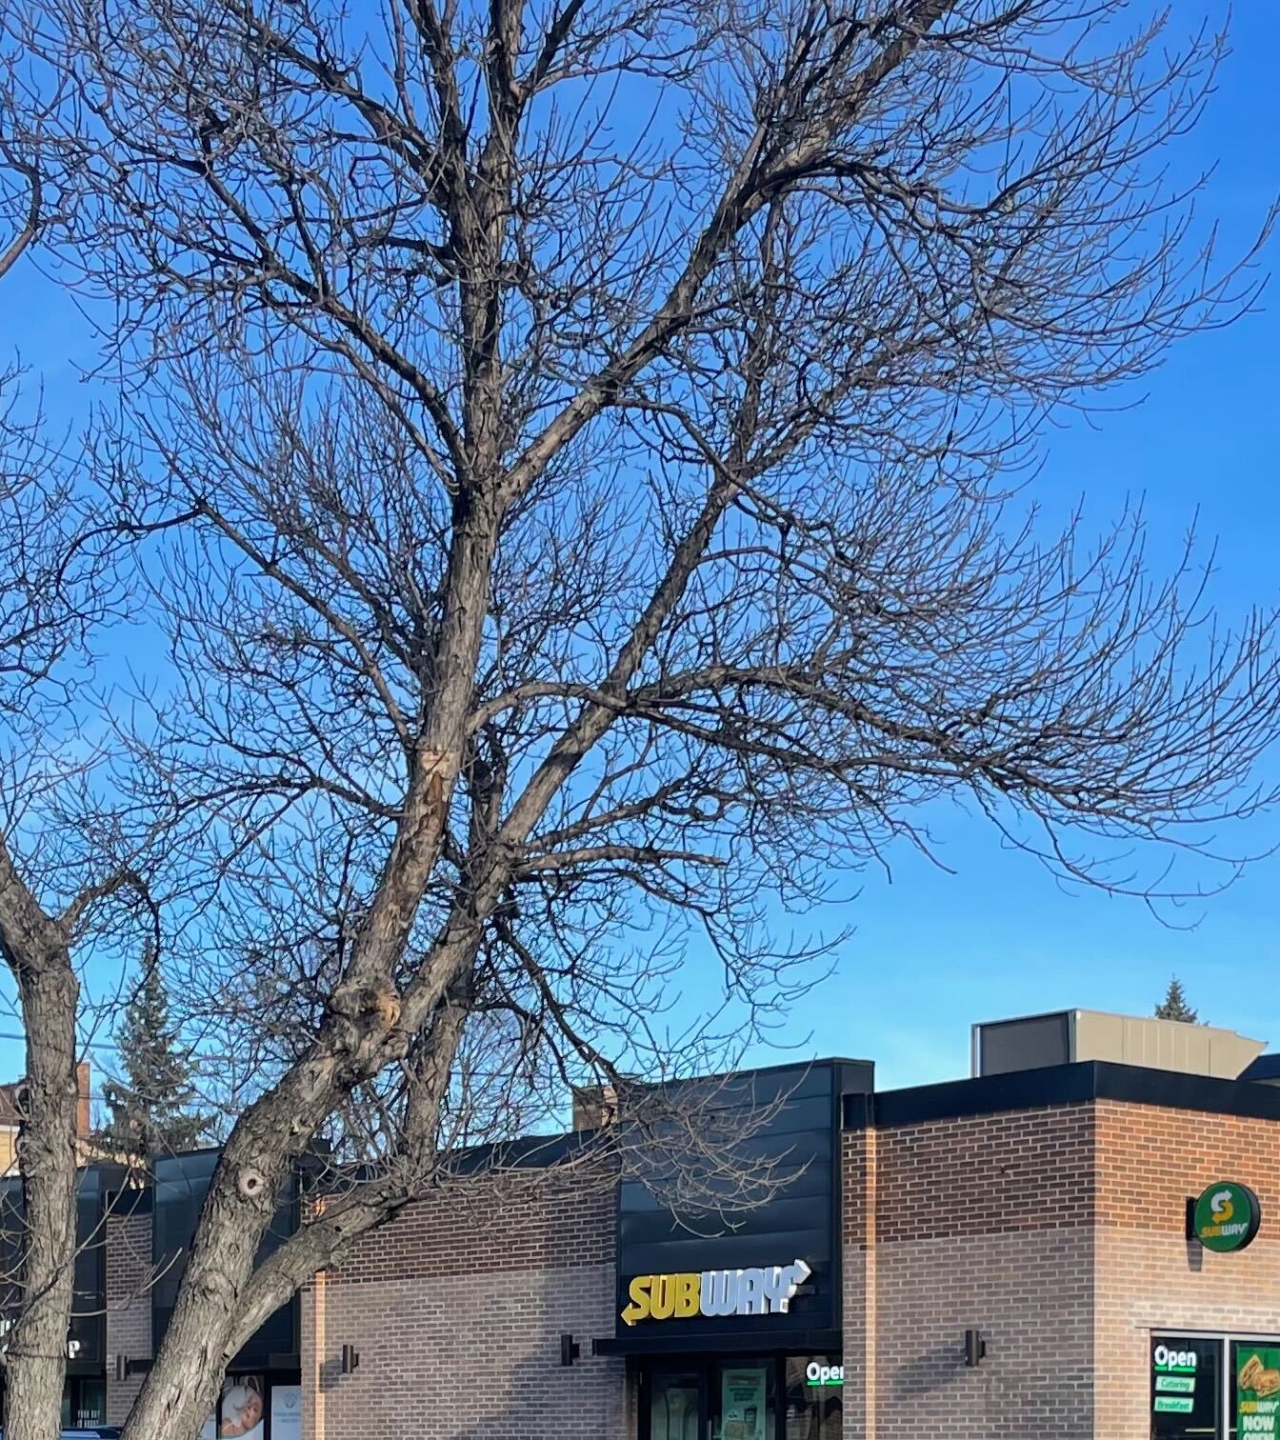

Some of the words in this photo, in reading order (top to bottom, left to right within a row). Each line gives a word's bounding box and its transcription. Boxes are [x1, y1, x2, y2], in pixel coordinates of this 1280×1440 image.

[1200, 1222, 1248, 1238] SUBWAY
[620, 1258, 812, 1327] SUBWAY
[1154, 1344, 1197, 1372] Open
[1161, 1378, 1191, 1391] Catering
[1239, 1400, 1279, 1414] SUBWAY
[1242, 1415, 1275, 1432] NOW
